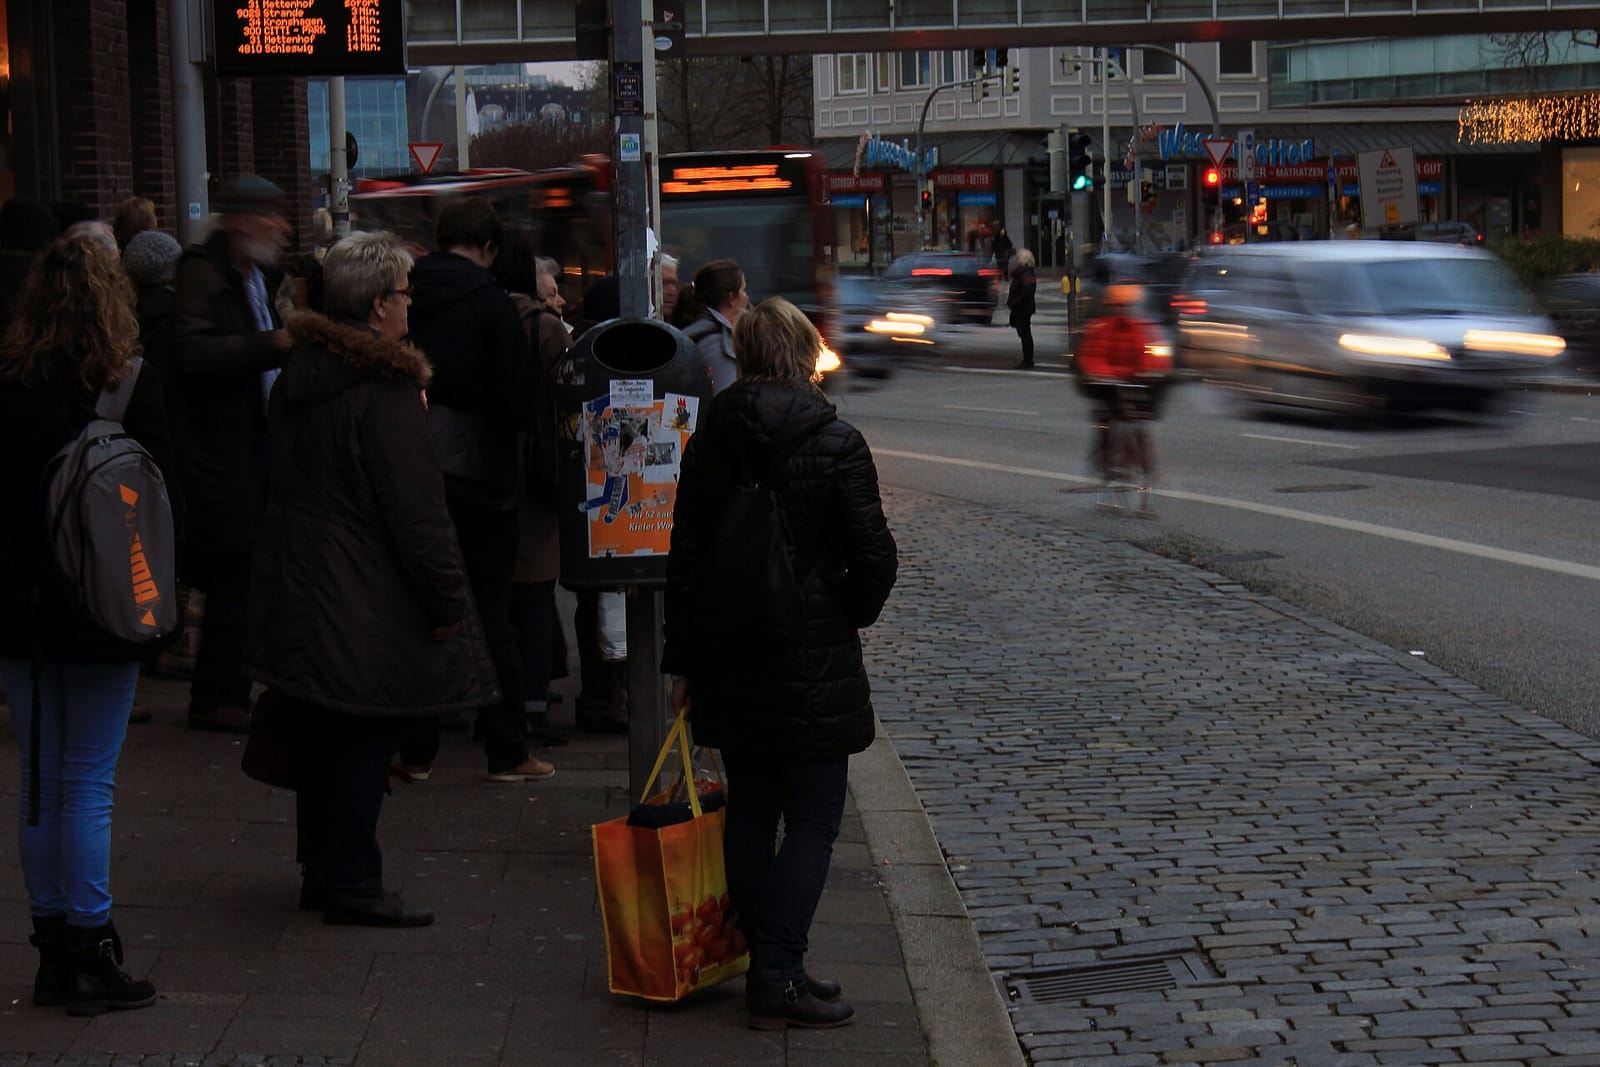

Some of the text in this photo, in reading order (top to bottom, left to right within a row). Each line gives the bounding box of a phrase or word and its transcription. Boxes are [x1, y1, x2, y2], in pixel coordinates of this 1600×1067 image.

[248, 0, 260, 8] 31
[262, 0, 314, 8] Mettenhof
[263, 8, 304, 17] Strande
[359, 7, 380, 16] Min.
[264, 17, 323, 26] Kronshagen
[359, 16, 380, 24] Min.
[243, 26, 262, 36] 300
[302, 25, 326, 35] PARK
[347, 24, 357, 33] 11
[360, 24, 380, 33] Min.
[250, 34, 261, 44] 31
[264, 34, 316, 44] Mettenhof
[360, 33, 380, 42] Min.
[265, 44, 314, 54] Schleswig
[361, 42, 381, 52] Min.
[1275, 168, 1323, 177] MATRATZEN
[1424, 164, 1442, 175] GUT
[629, 522, 655, 532] Kieler
